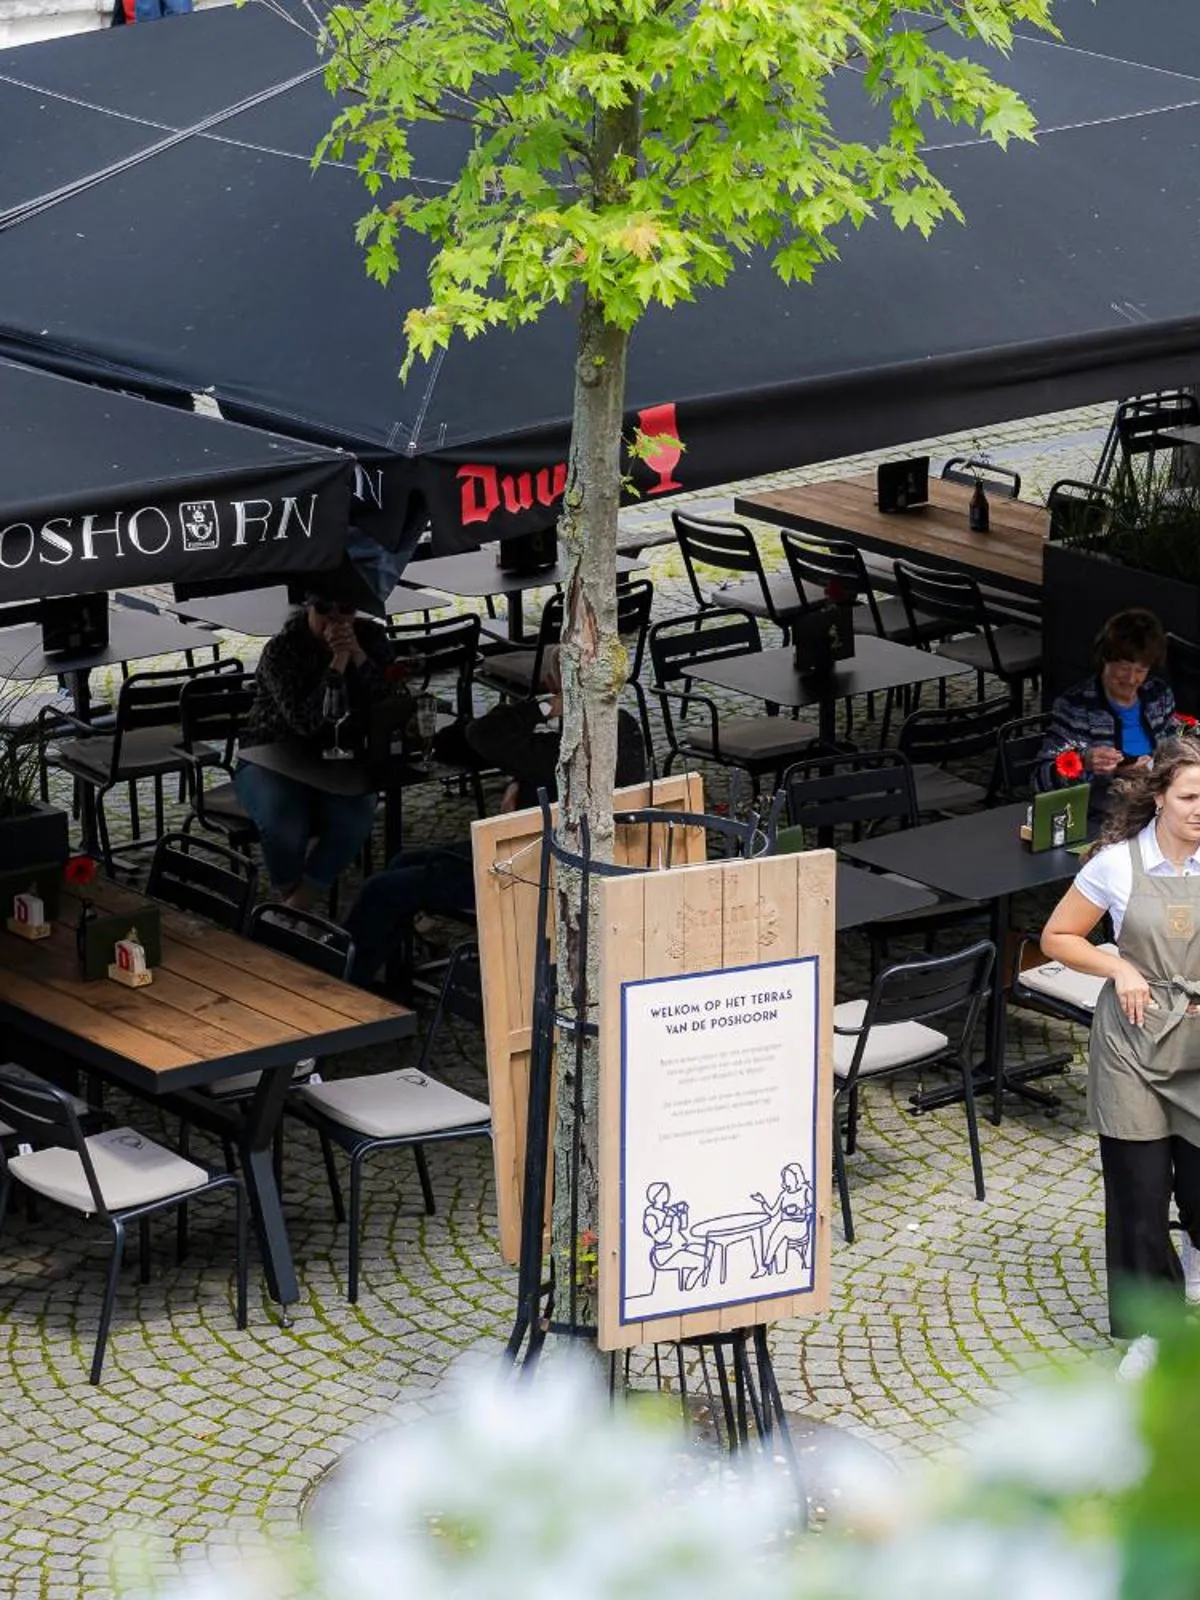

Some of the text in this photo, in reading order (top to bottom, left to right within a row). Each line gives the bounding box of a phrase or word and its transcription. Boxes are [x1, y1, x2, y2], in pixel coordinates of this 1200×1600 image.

[456, 463, 567, 526] Duv
[650, 989, 793, 1019] WELKOM OP HET TERRAS
[665, 1009, 778, 1034] VAN DE POSHOORN
